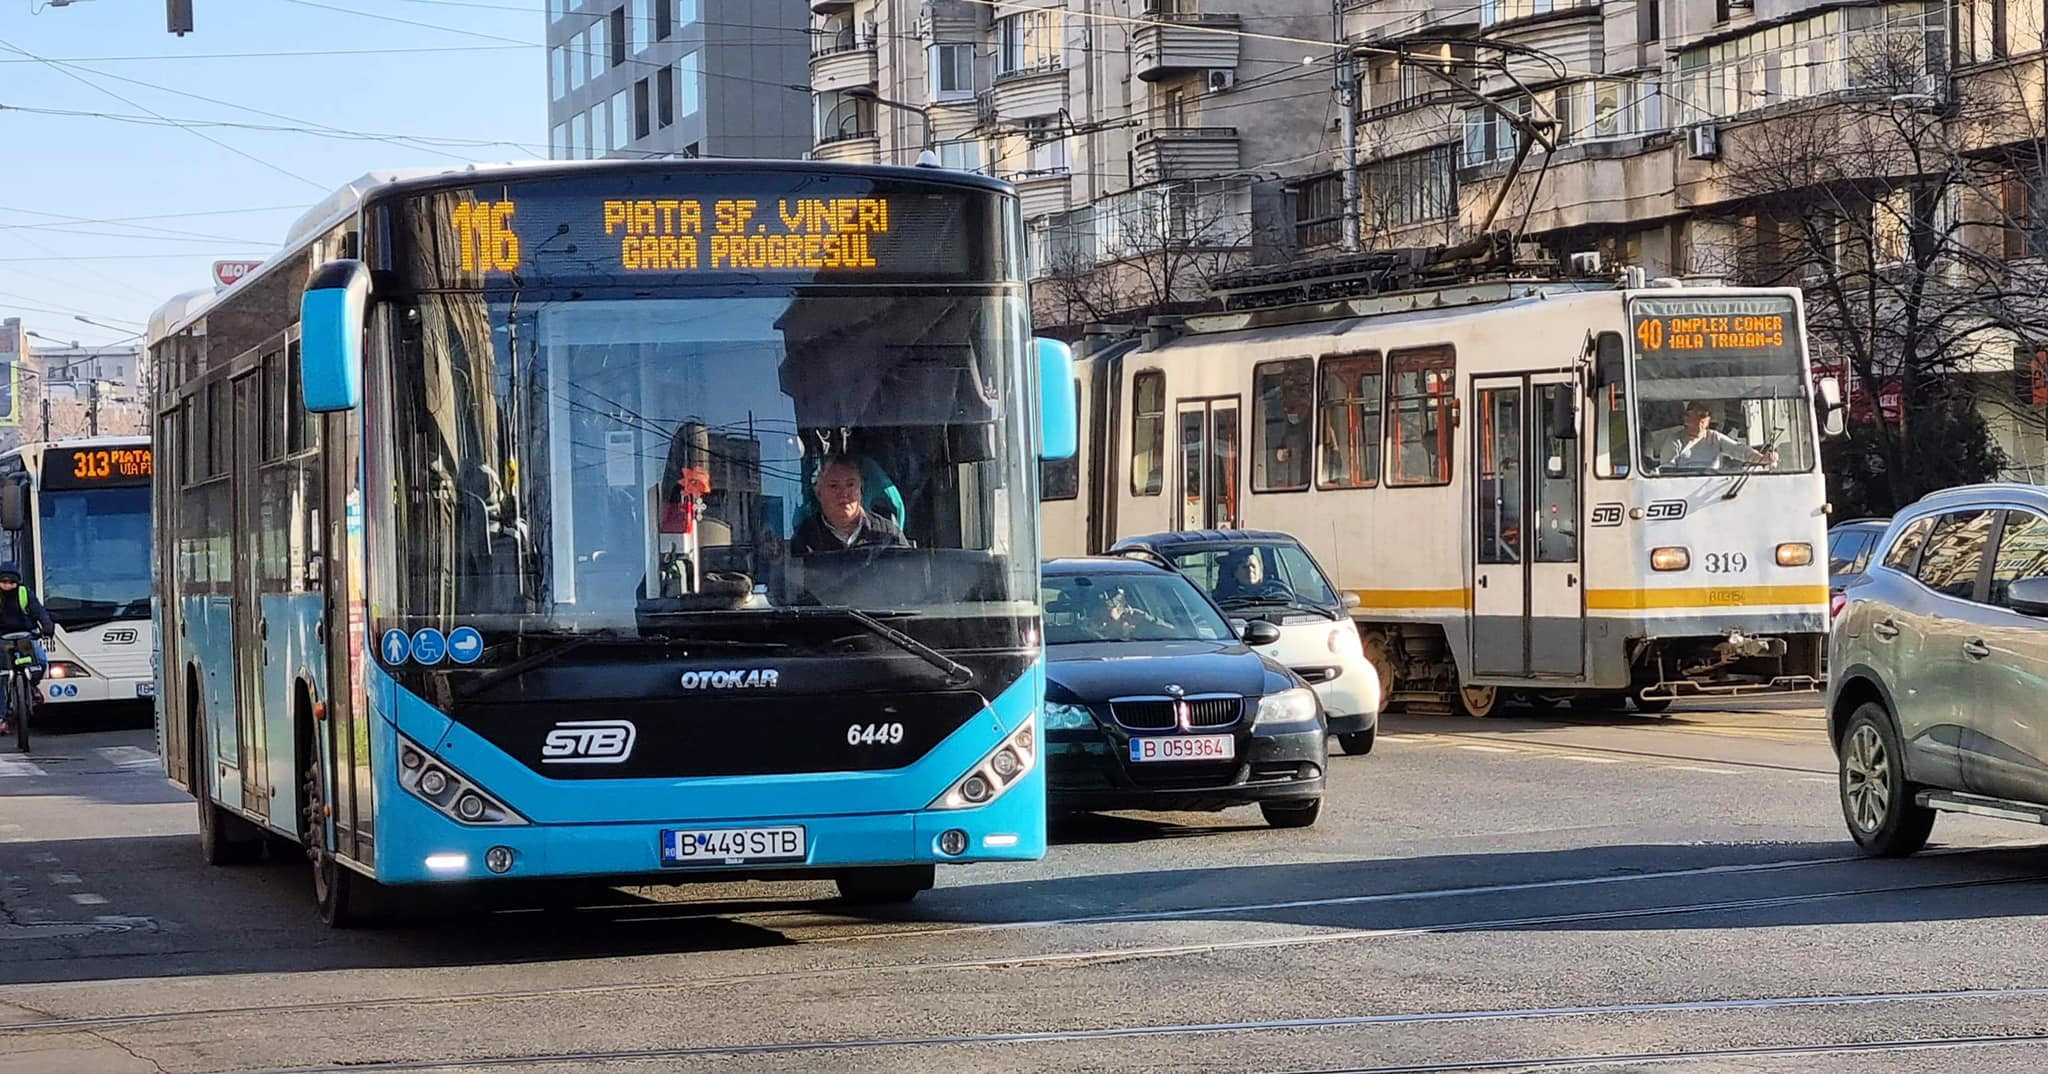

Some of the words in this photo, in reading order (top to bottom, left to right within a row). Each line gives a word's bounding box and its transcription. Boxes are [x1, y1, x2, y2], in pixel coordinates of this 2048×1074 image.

[604, 200, 701, 234] PIATA
[715, 199, 766, 233] SF.
[778, 198, 888, 233] VINERI
[452, 201, 519, 272] 116
[622, 235, 699, 270] GARA
[710, 234, 876, 269] PROGRESUL
[1637, 319, 1662, 349] 40
[1668, 317, 1729, 333] OMPLEX
[1735, 316, 1783, 331] COMER
[73, 451, 110, 478] 313
[111, 450, 151, 463] PIATA
[1591, 506, 1621, 524] STB
[1646, 502, 1684, 517] STB
[1705, 552, 1747, 574] 319
[102, 630, 136, 643] STB
[681, 669, 778, 689] OTOKAR
[542, 727, 629, 757] STB
[847, 722, 904, 745] 6449
[1144, 741, 1156, 757] B
[1163, 739, 1223, 757] 059364
[704, 832, 746, 855] 449
[750, 831, 797, 854] STB
